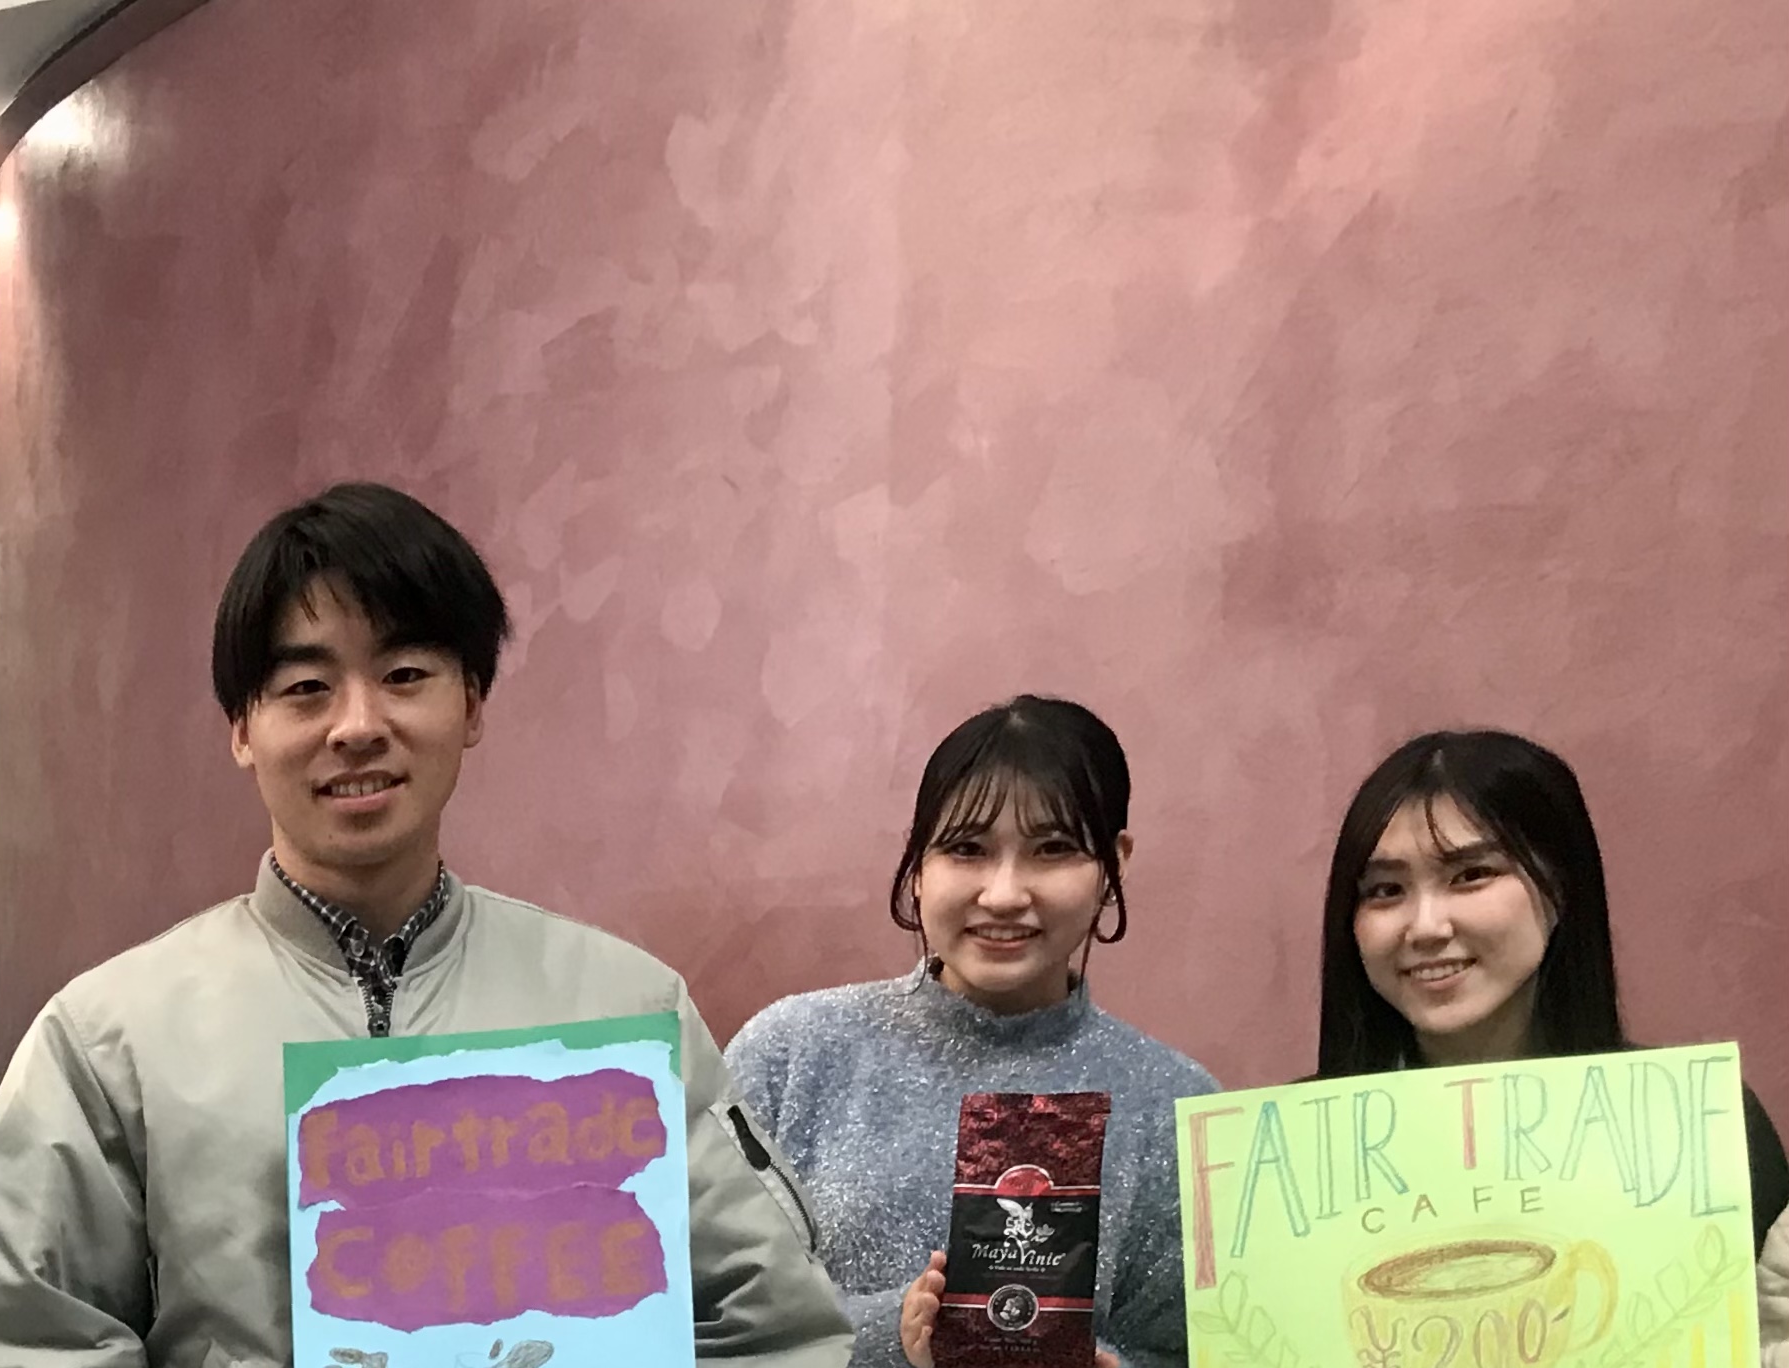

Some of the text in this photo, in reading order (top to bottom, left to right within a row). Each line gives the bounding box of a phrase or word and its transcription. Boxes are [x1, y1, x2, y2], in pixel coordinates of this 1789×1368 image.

[1188, 1056, 1740, 1290] FAIR TRADE
[1361, 1186, 1547, 1234] CAFE
[317, 1219, 649, 1311] COFFEE
